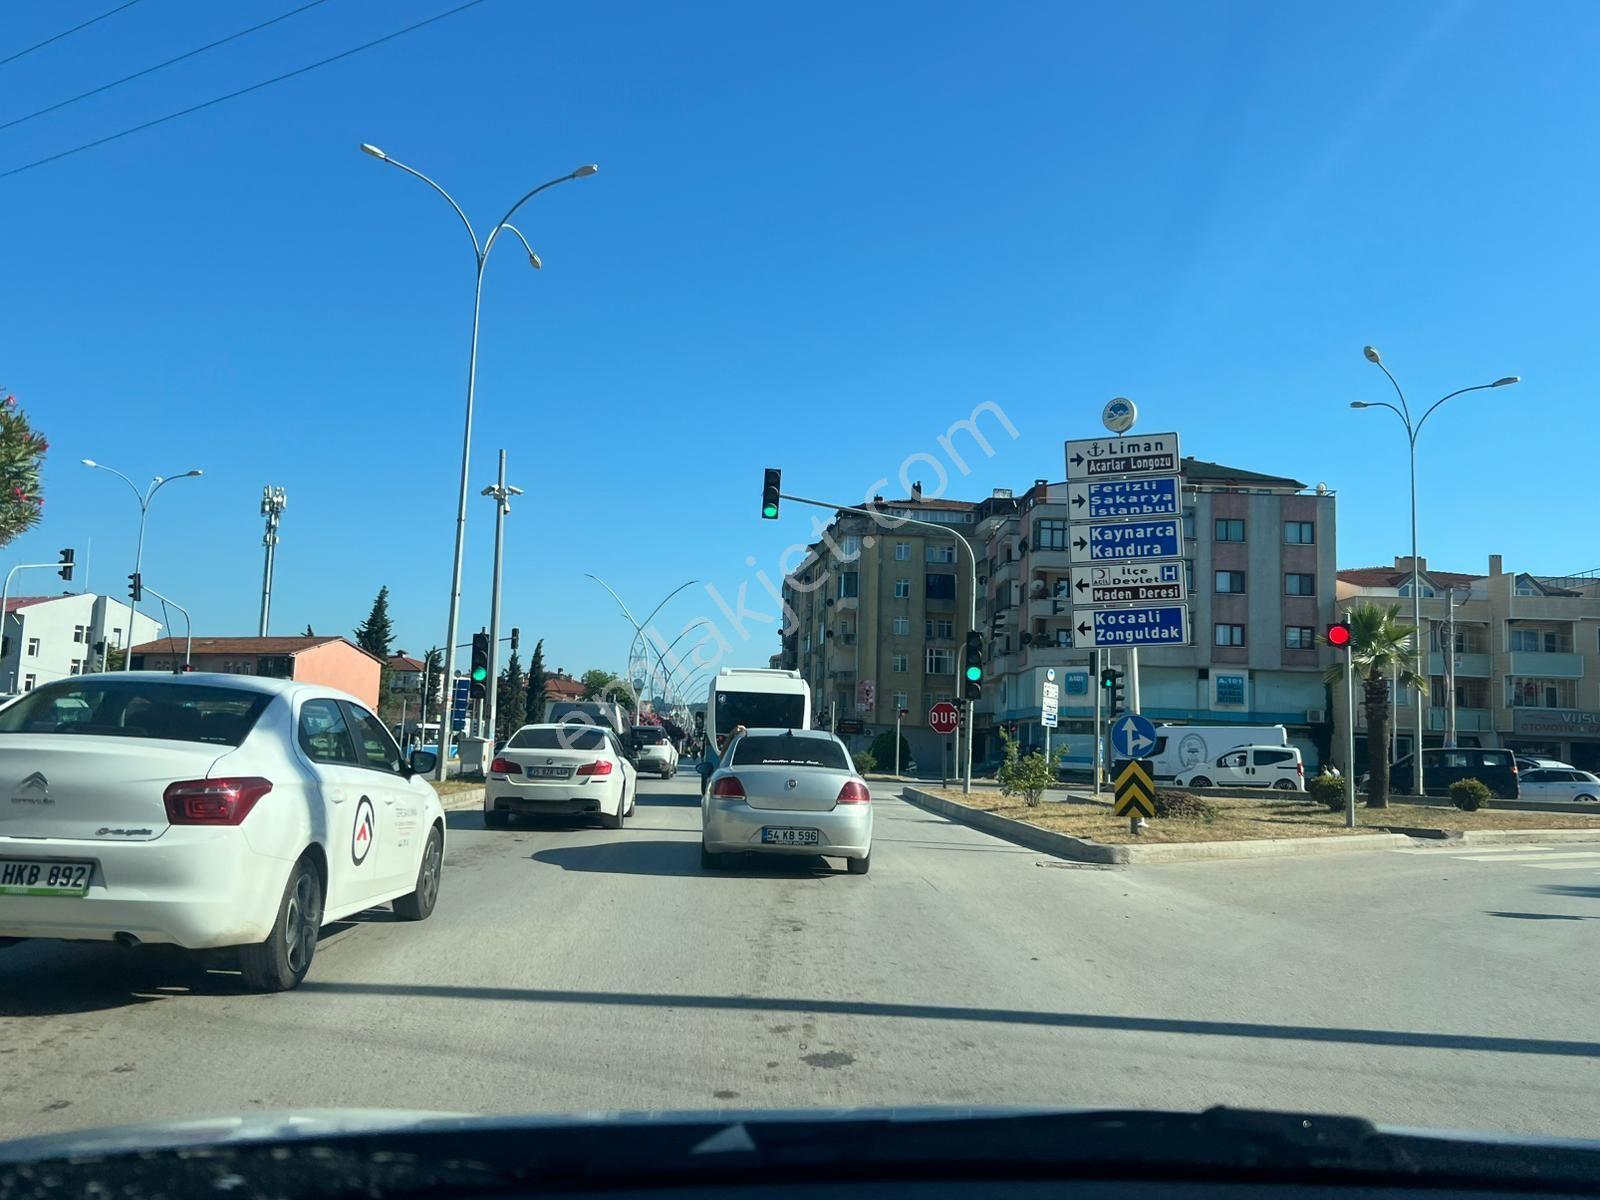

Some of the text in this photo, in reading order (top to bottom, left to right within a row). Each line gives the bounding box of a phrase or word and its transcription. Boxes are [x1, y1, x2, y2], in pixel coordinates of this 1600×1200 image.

[1108, 441, 1164, 455] Liman
[1089, 456, 1172, 473] Acarlar Longozu
[1090, 481, 1157, 494] Ferizli
[1091, 493, 1173, 505] Sakarya
[1091, 526, 1175, 541] Kaynarca
[1092, 544, 1162, 558] Kandıra
[1164, 567, 1176, 580] H
[1112, 577, 1159, 585] Devlet
[1094, 587, 1179, 601] Maden Deresi
[1095, 611, 1161, 625] Kocaali
[1096, 626, 1180, 642] Zonguldak
[931, 711, 957, 724] DUR
[767, 829, 816, 841] 54 KB 596
[1, 863, 86, 888] HKB 892
